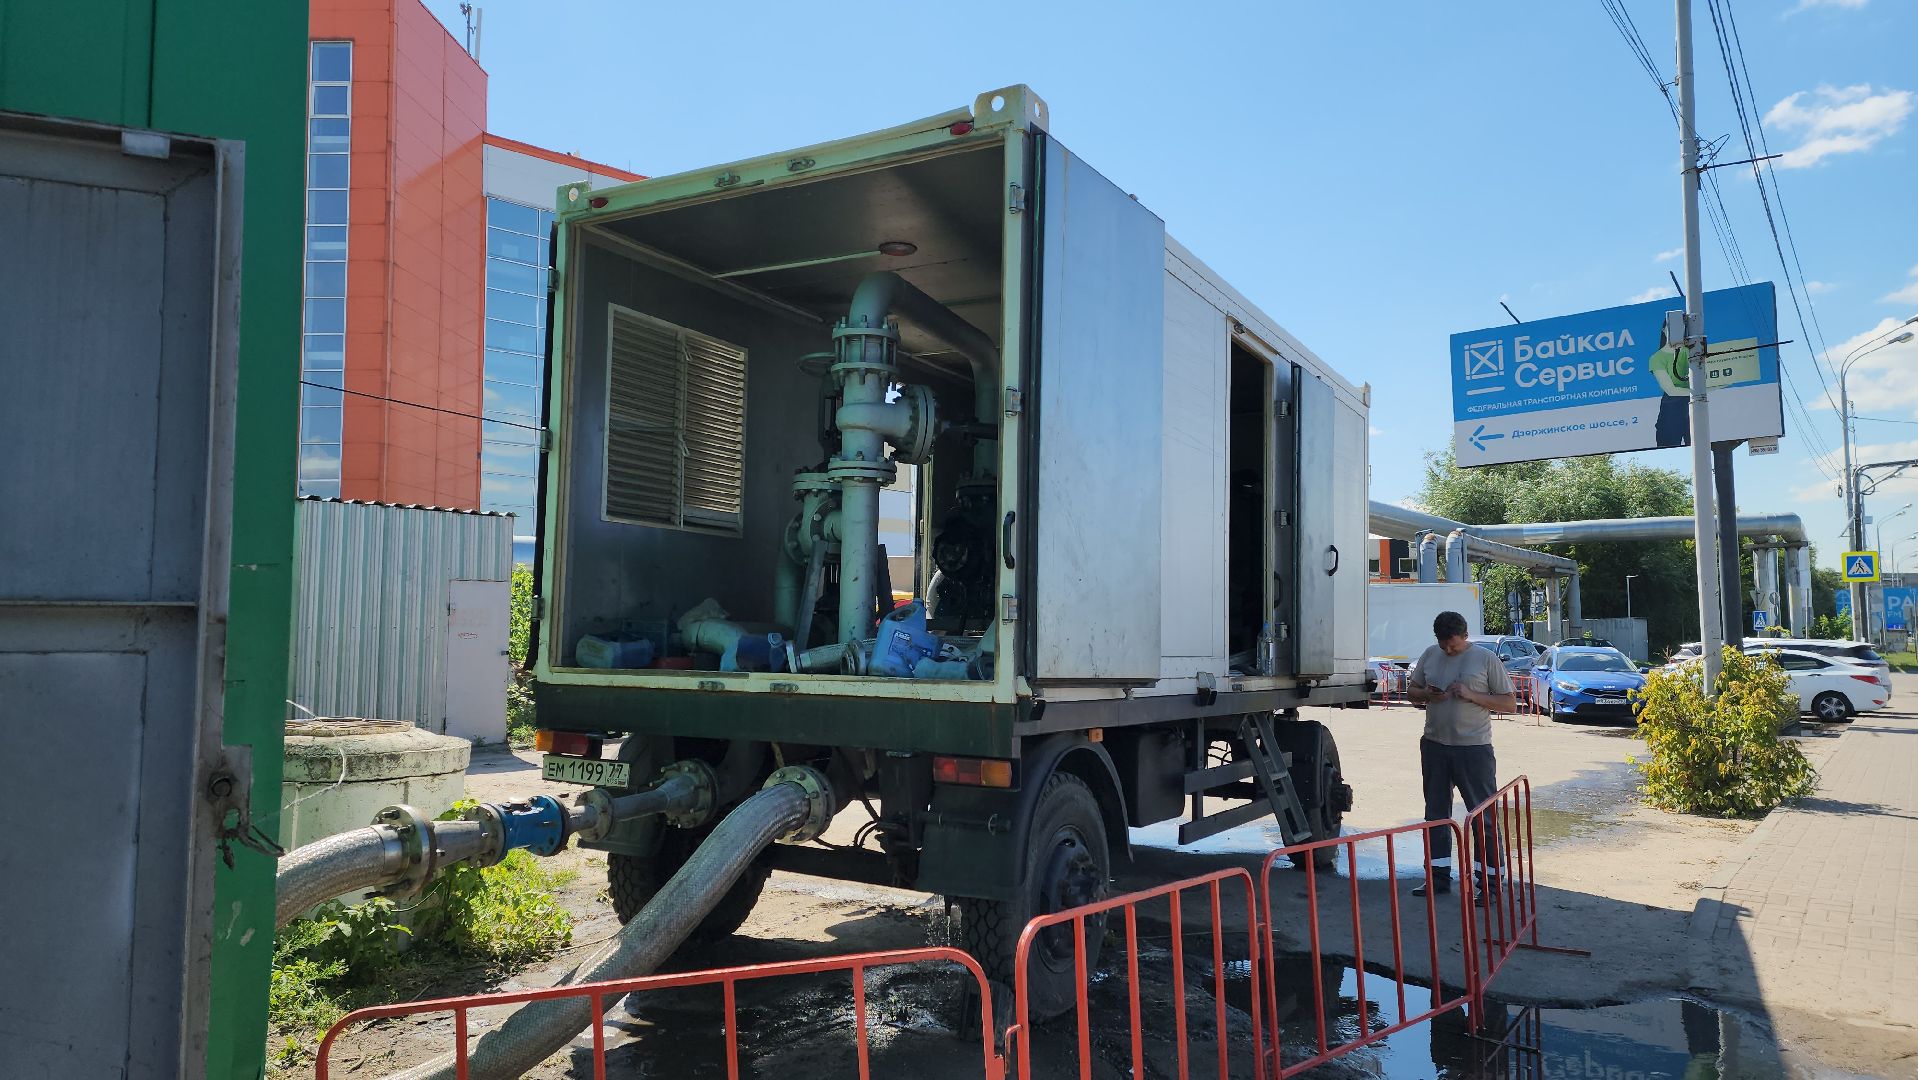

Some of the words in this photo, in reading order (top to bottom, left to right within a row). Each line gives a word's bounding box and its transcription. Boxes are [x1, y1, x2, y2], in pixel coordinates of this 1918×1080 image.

[1514, 328, 1635, 362] Байкал
[1514, 356, 1635, 392] Сервис
[1467, 400, 1522, 413] ФЕДЕРАЛЬНАЯ
[1524, 392, 1587, 406] ТРАНСПОРТНАЯ
[1588, 385, 1638, 398] КОМПАНИЯ
[1511, 423, 1586, 439] Дзержинское
[1631, 416, 1639, 425] 2
[569, 760, 604, 782] 1199
[608, 763, 624, 778] 77
